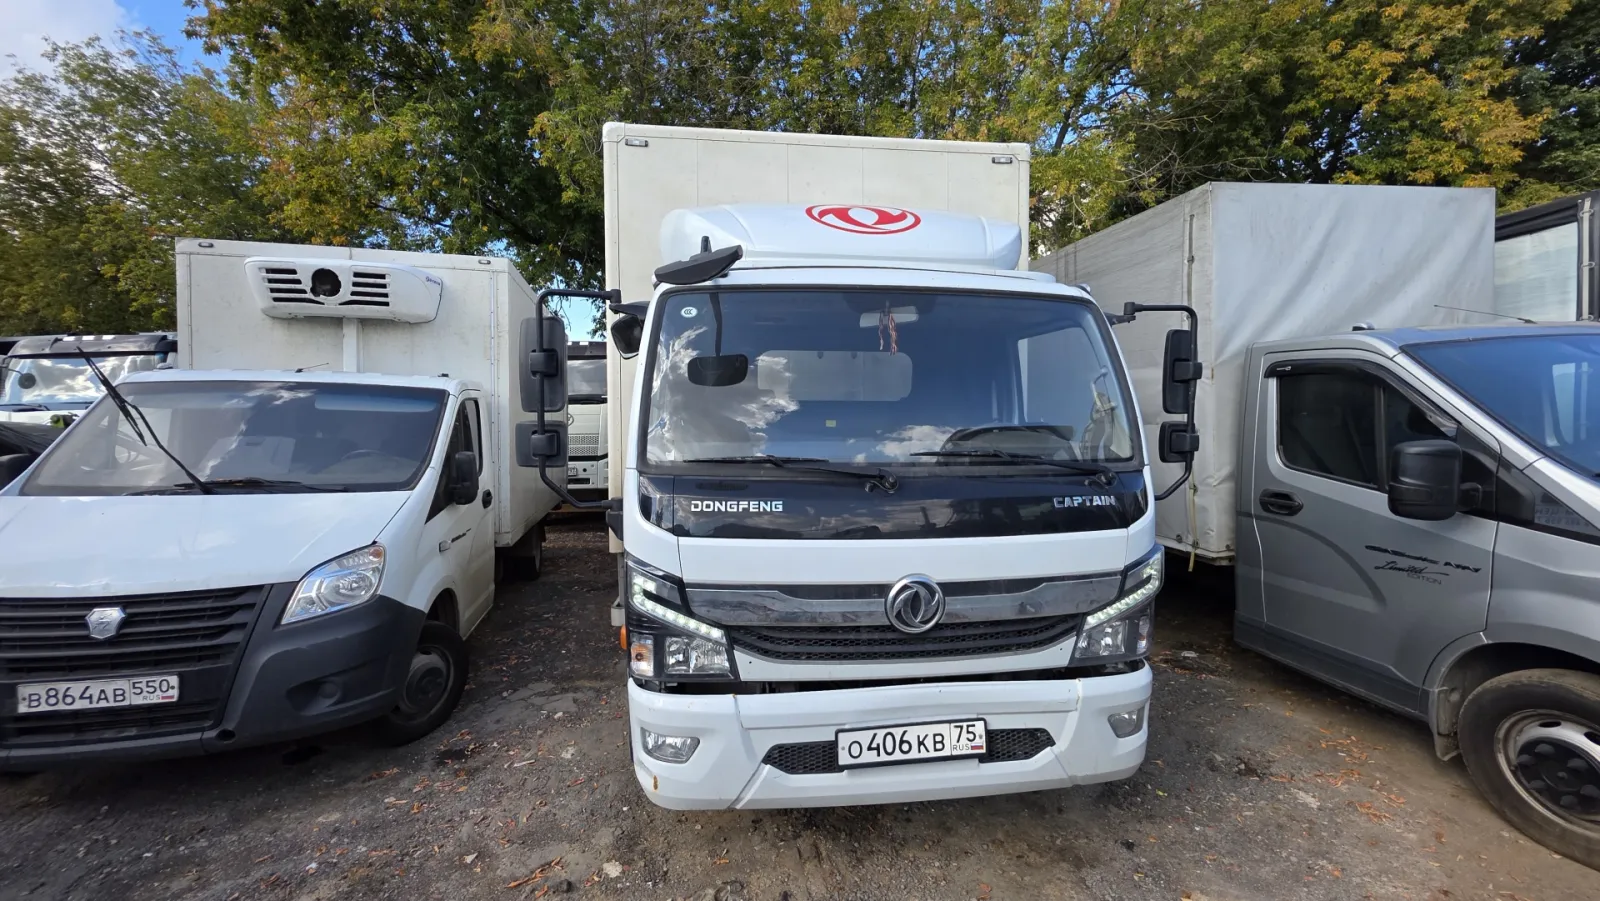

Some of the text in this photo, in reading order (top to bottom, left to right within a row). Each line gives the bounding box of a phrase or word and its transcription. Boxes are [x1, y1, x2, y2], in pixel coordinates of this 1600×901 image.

[690, 500, 783, 512] DONGFENG
[1053, 495, 1116, 508] CAPTAIN
[1374, 560, 1450, 576] Limited
[1407, 573, 1442, 585] EDITION
[131, 678, 170, 695] 550
[953, 723, 977, 744] 75
[952, 743, 970, 752] RUS
